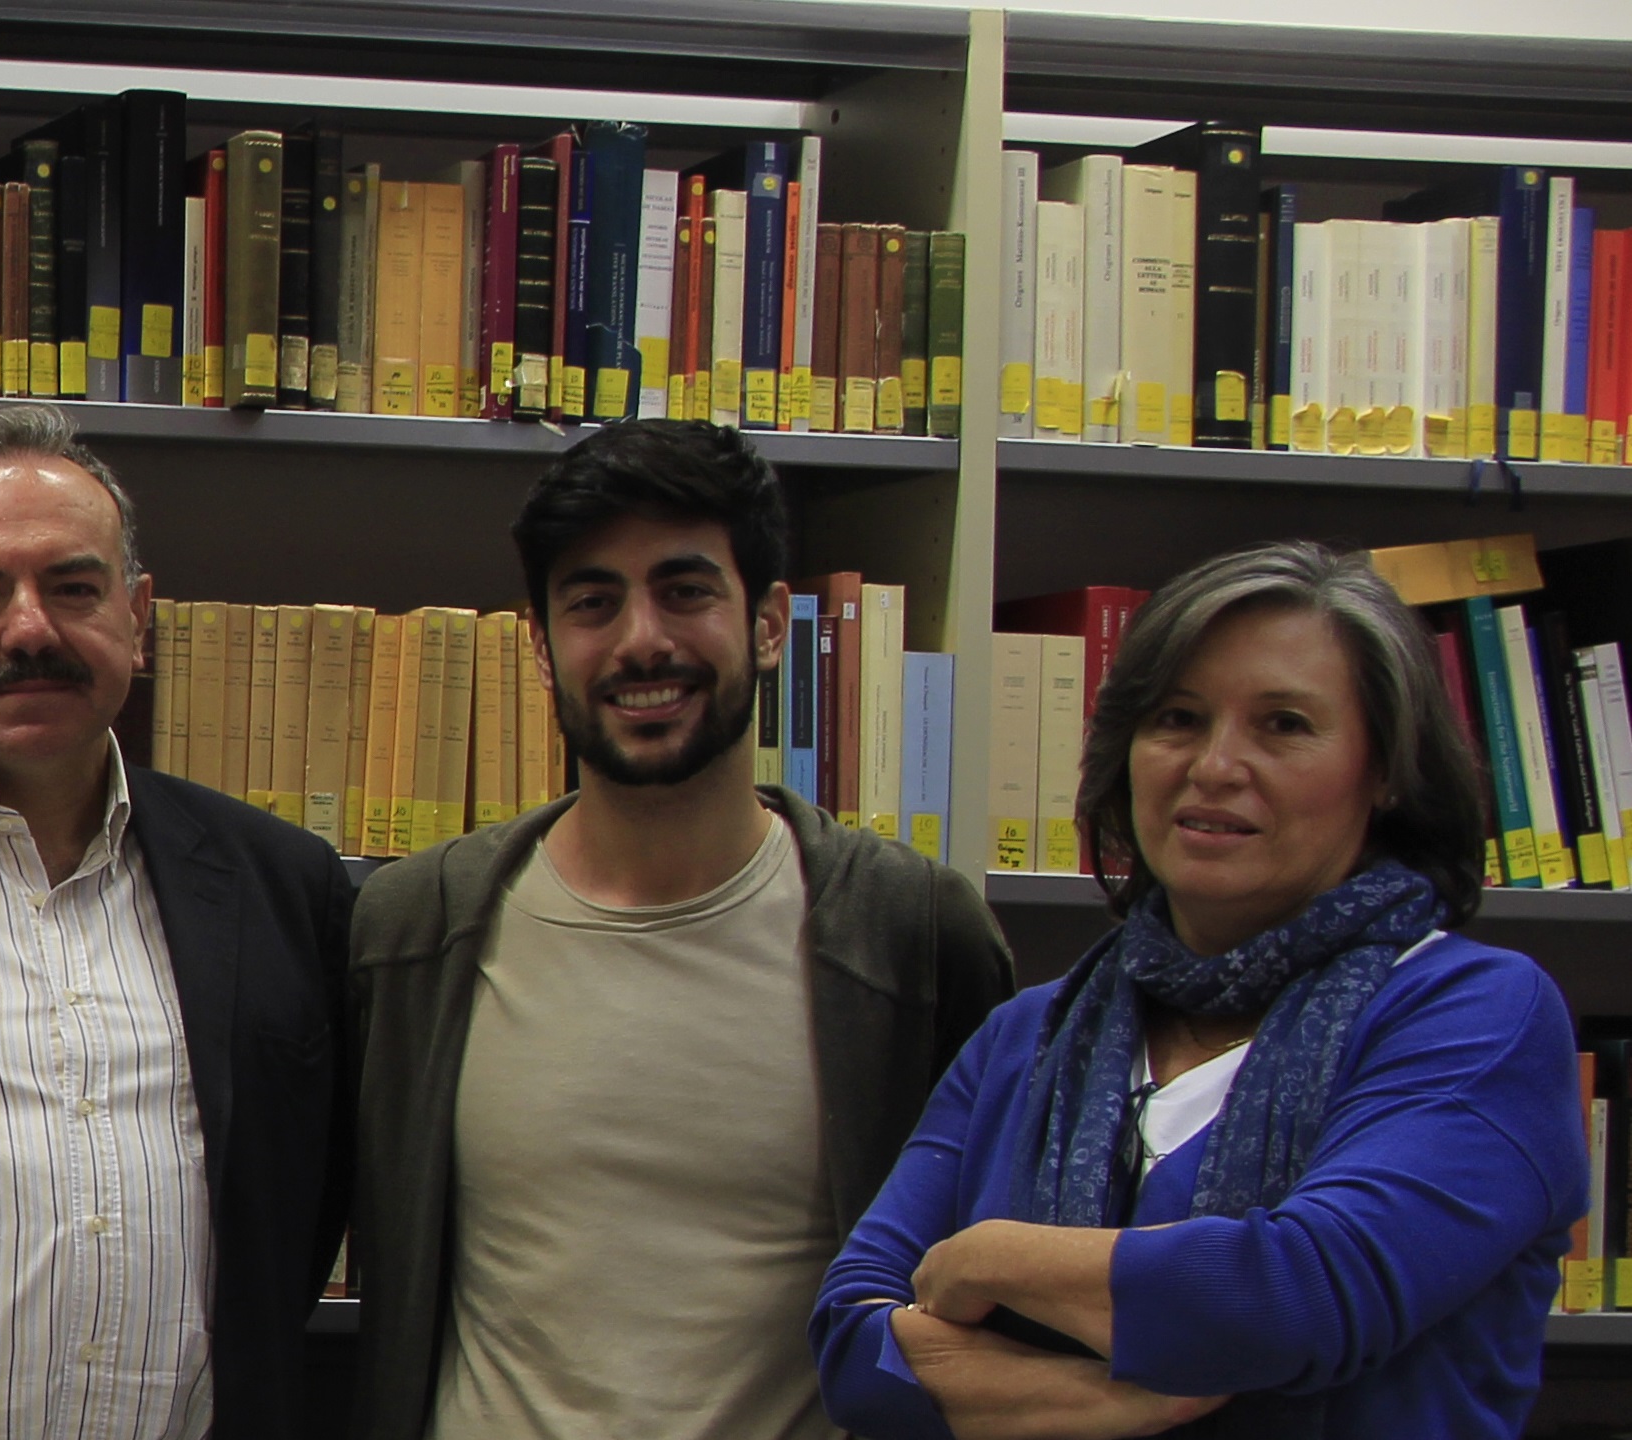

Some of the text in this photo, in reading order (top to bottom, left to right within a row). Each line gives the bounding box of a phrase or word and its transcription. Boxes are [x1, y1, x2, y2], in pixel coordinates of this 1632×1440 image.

[1103, 244, 1114, 281] Origenes
[1137, 272, 1166, 280] LETTERA
[1013, 270, 1026, 308] Origenes
[1487, 671, 1506, 726] Instructions
[1502, 755, 1519, 813] Netherworld
[1583, 798, 1597, 828] Religion
[1005, 826, 1017, 838] 10
